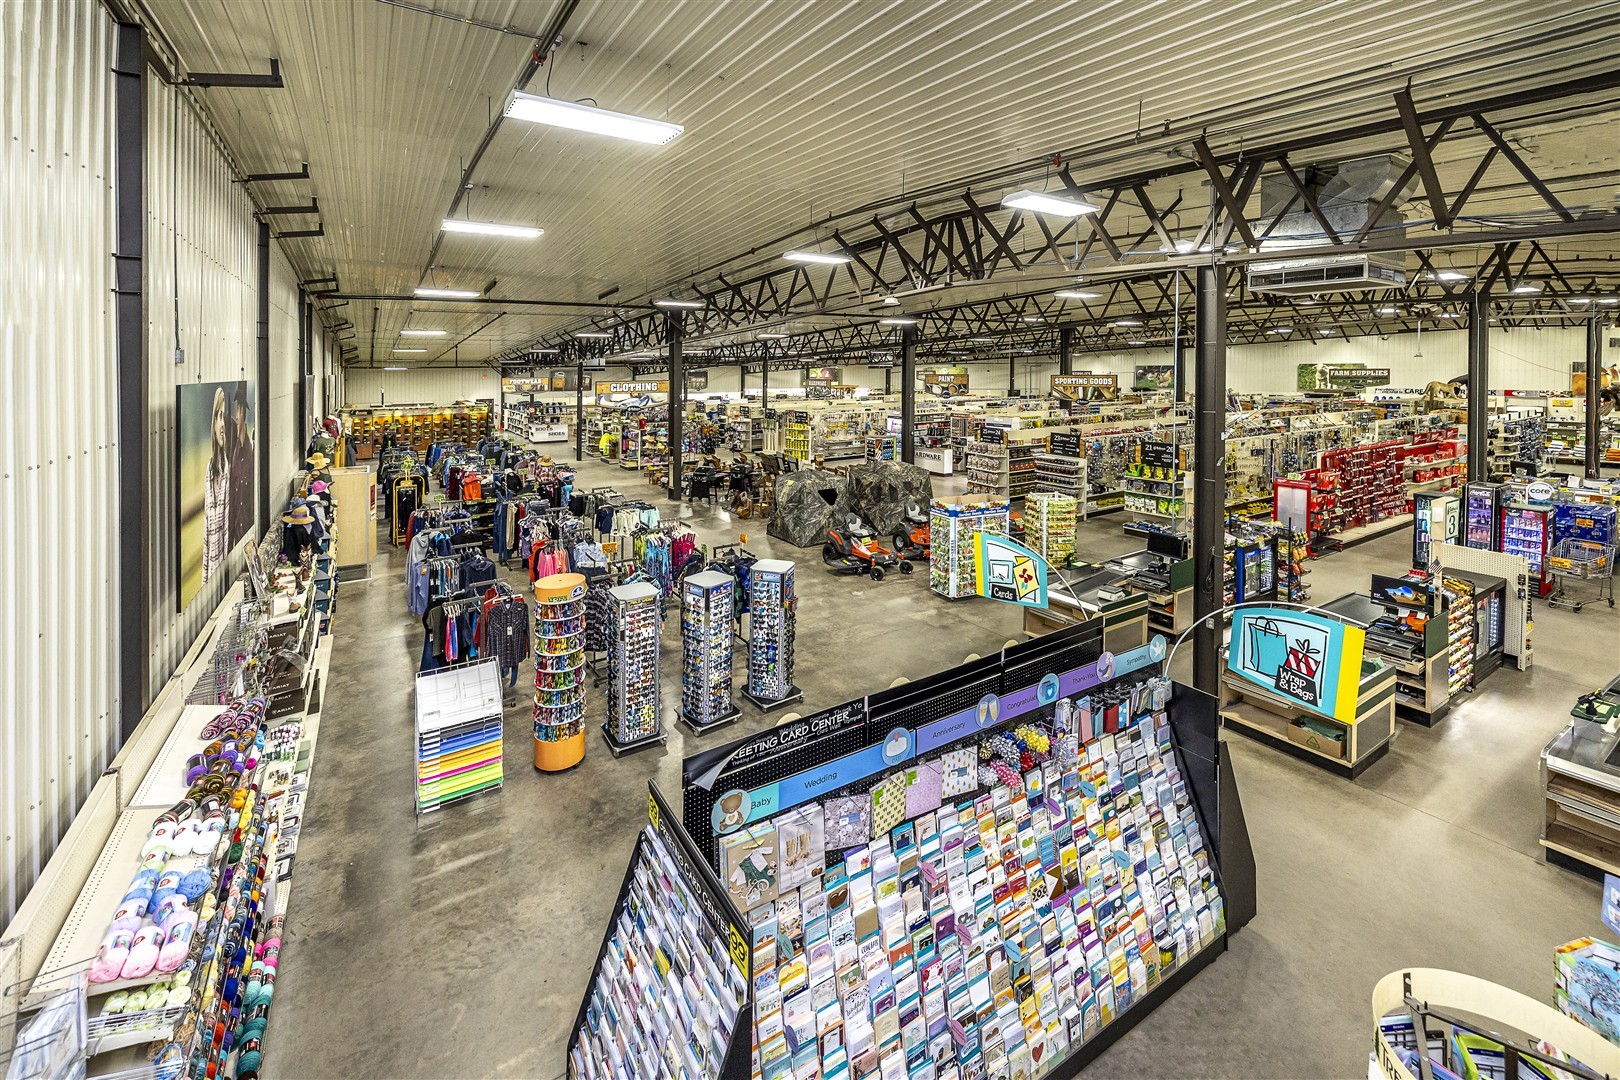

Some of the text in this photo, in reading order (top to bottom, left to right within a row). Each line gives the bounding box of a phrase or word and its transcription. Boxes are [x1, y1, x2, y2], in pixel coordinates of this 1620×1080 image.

[938, 375, 955, 383] PAINT
[1054, 377, 1113, 385] SPORTING GOODS
[610, 382, 658, 392] CLOTHING
[914, 451, 942, 461] ARDWARE
[1449, 515, 1455, 535] 3
[993, 587, 1014, 600] Cards
[1126, 654, 1147, 666] Sympathy
[1072, 672, 1096, 684] Thank-You
[1279, 667, 1307, 688] Wrap
[1279, 679, 1315, 701] & Bags
[852, 702, 863, 710] Yo
[1007, 695, 1036, 711] Congratulat
[732, 711, 849, 760] EETING CARD CENTER
[932, 722, 966, 739] Anniversary
[732, 756, 749, 766] Thinking
[804, 771, 838, 789] Wedding
[751, 796, 772, 810] Baby
[658, 818, 730, 937] GREETING CARD CENTER
